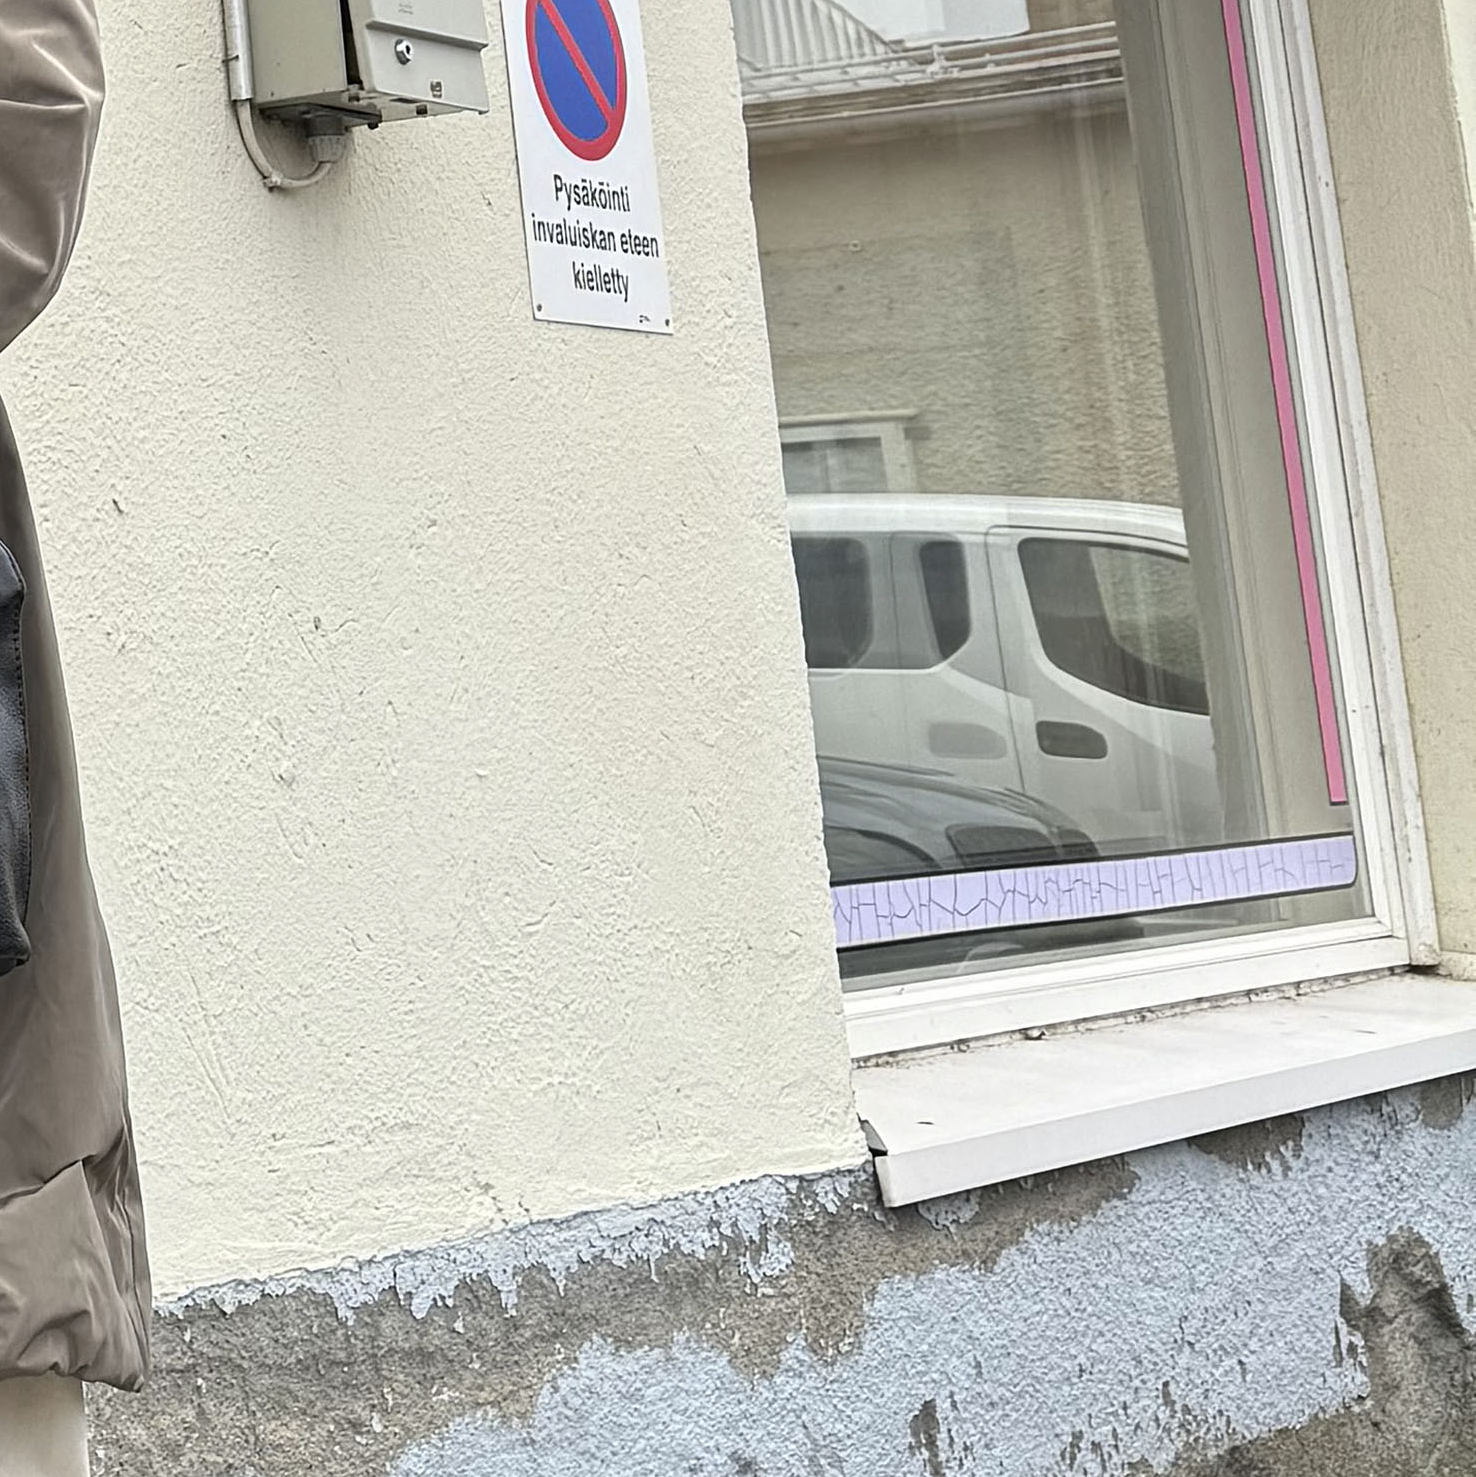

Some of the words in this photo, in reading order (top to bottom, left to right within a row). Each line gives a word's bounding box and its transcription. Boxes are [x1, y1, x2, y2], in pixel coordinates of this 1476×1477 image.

[553, 174, 631, 212] Pysäköinti
[531, 212, 617, 252] invaluiskan
[620, 229, 660, 258] eteen
[572, 261, 629, 303] kielletty
